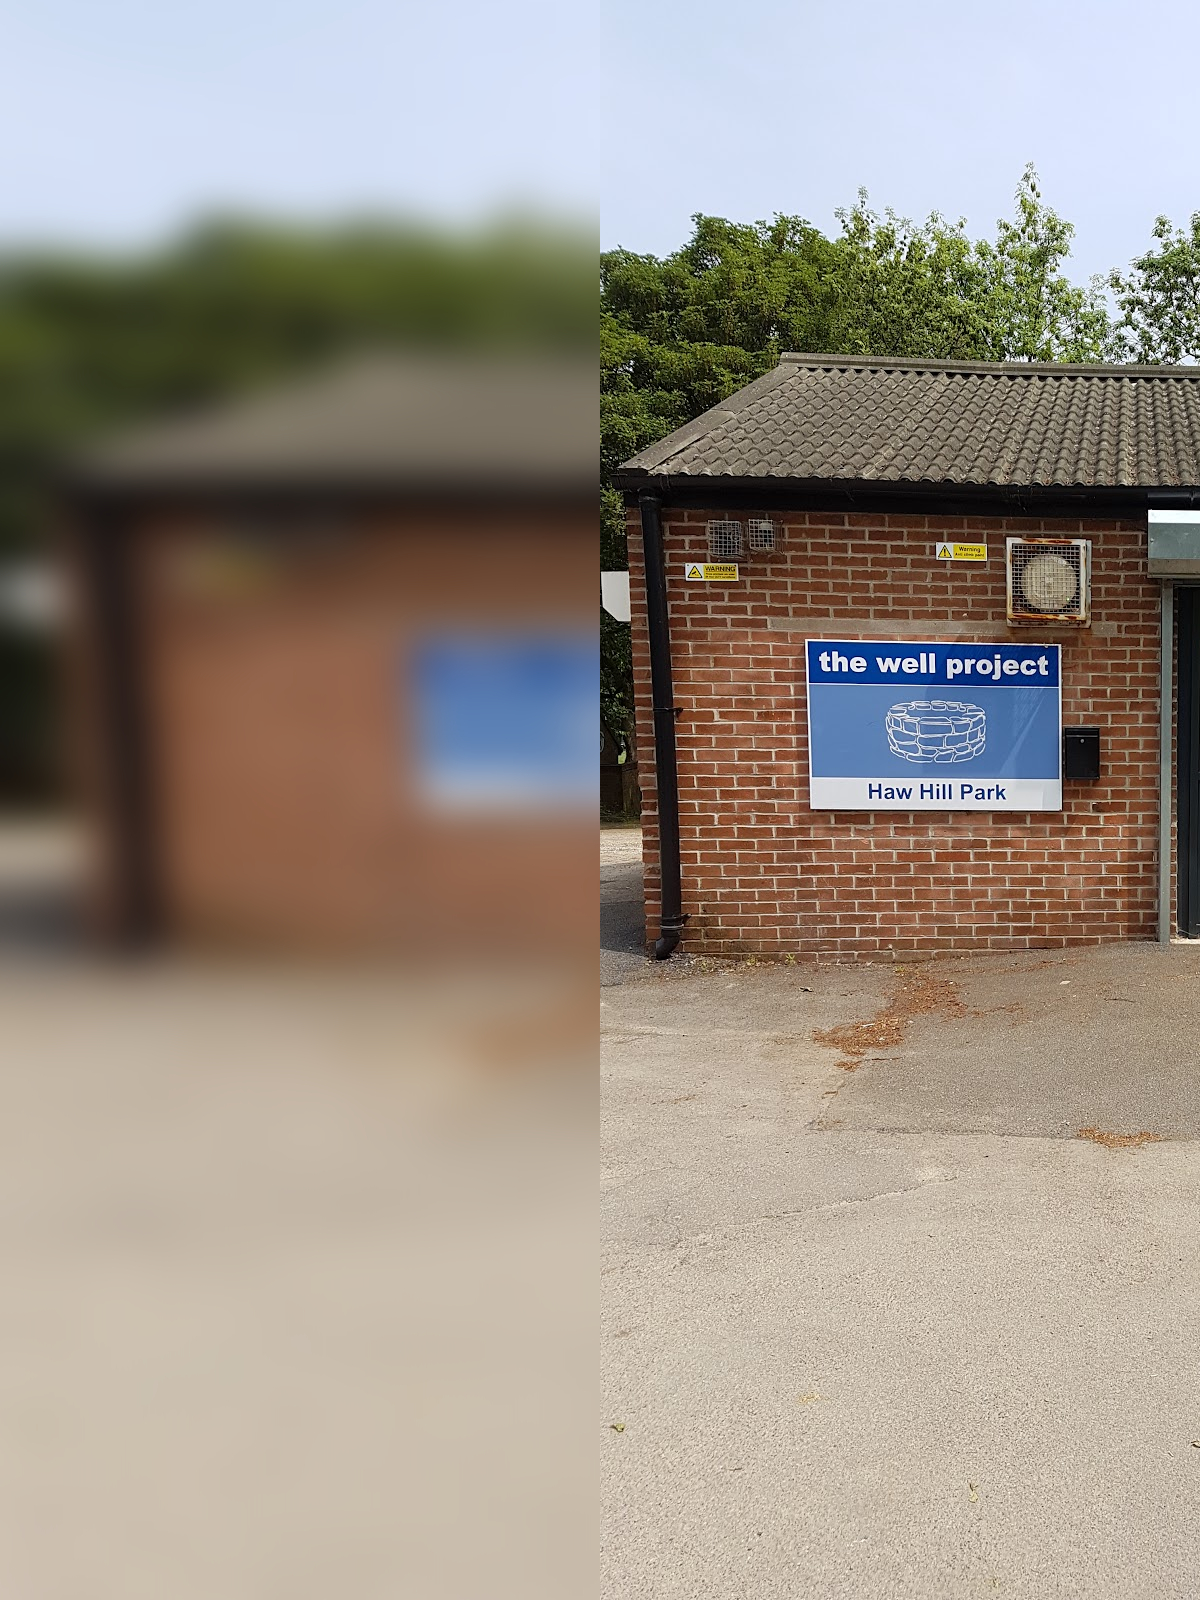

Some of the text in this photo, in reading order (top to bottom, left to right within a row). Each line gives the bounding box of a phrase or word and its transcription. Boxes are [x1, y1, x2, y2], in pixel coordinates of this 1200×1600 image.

[819, 651, 1049, 680] the well project
[868, 783, 1006, 800] Haw Hill Park
